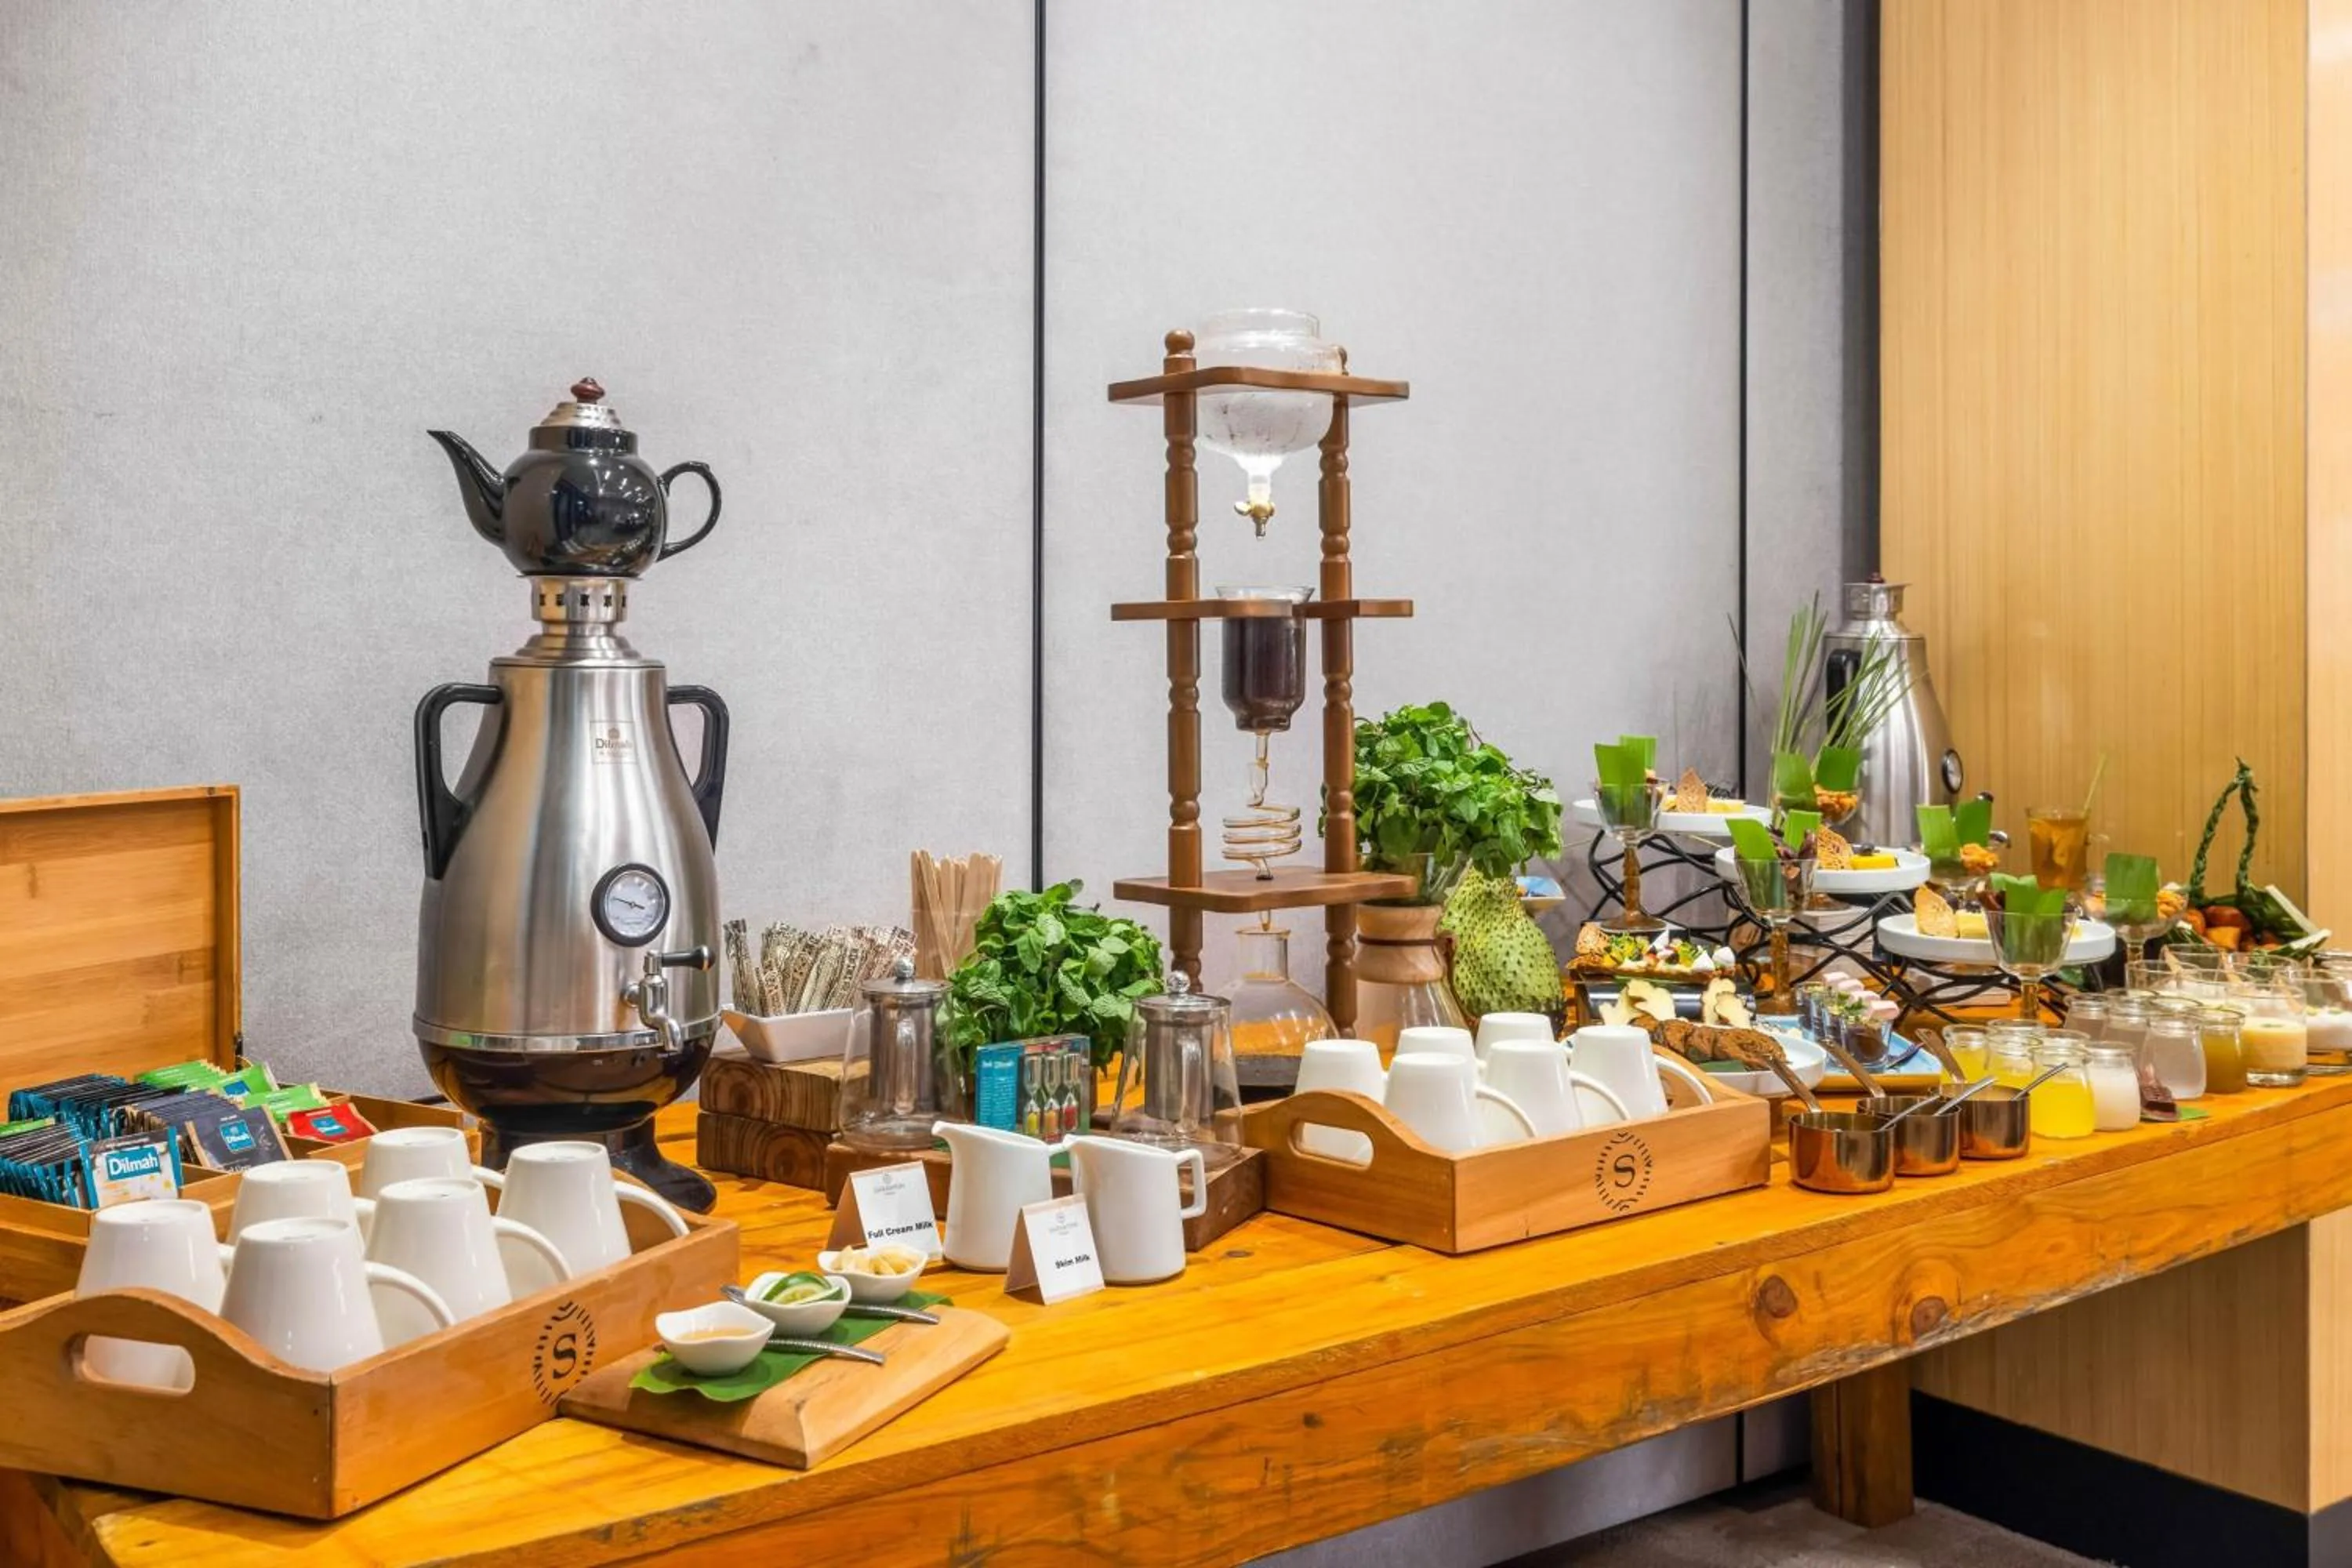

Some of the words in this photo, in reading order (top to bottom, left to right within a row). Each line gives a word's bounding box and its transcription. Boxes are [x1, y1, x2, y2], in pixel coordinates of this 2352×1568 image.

[109, 1152, 159, 1175] Dilmah
[1613, 1153, 1635, 1188] S
[868, 1229, 884, 1239] Full
[885, 1225, 913, 1236] Cream
[915, 1221, 933, 1230] Milk
[1075, 1254, 1091, 1264] Milk
[553, 1333, 576, 1380] S
